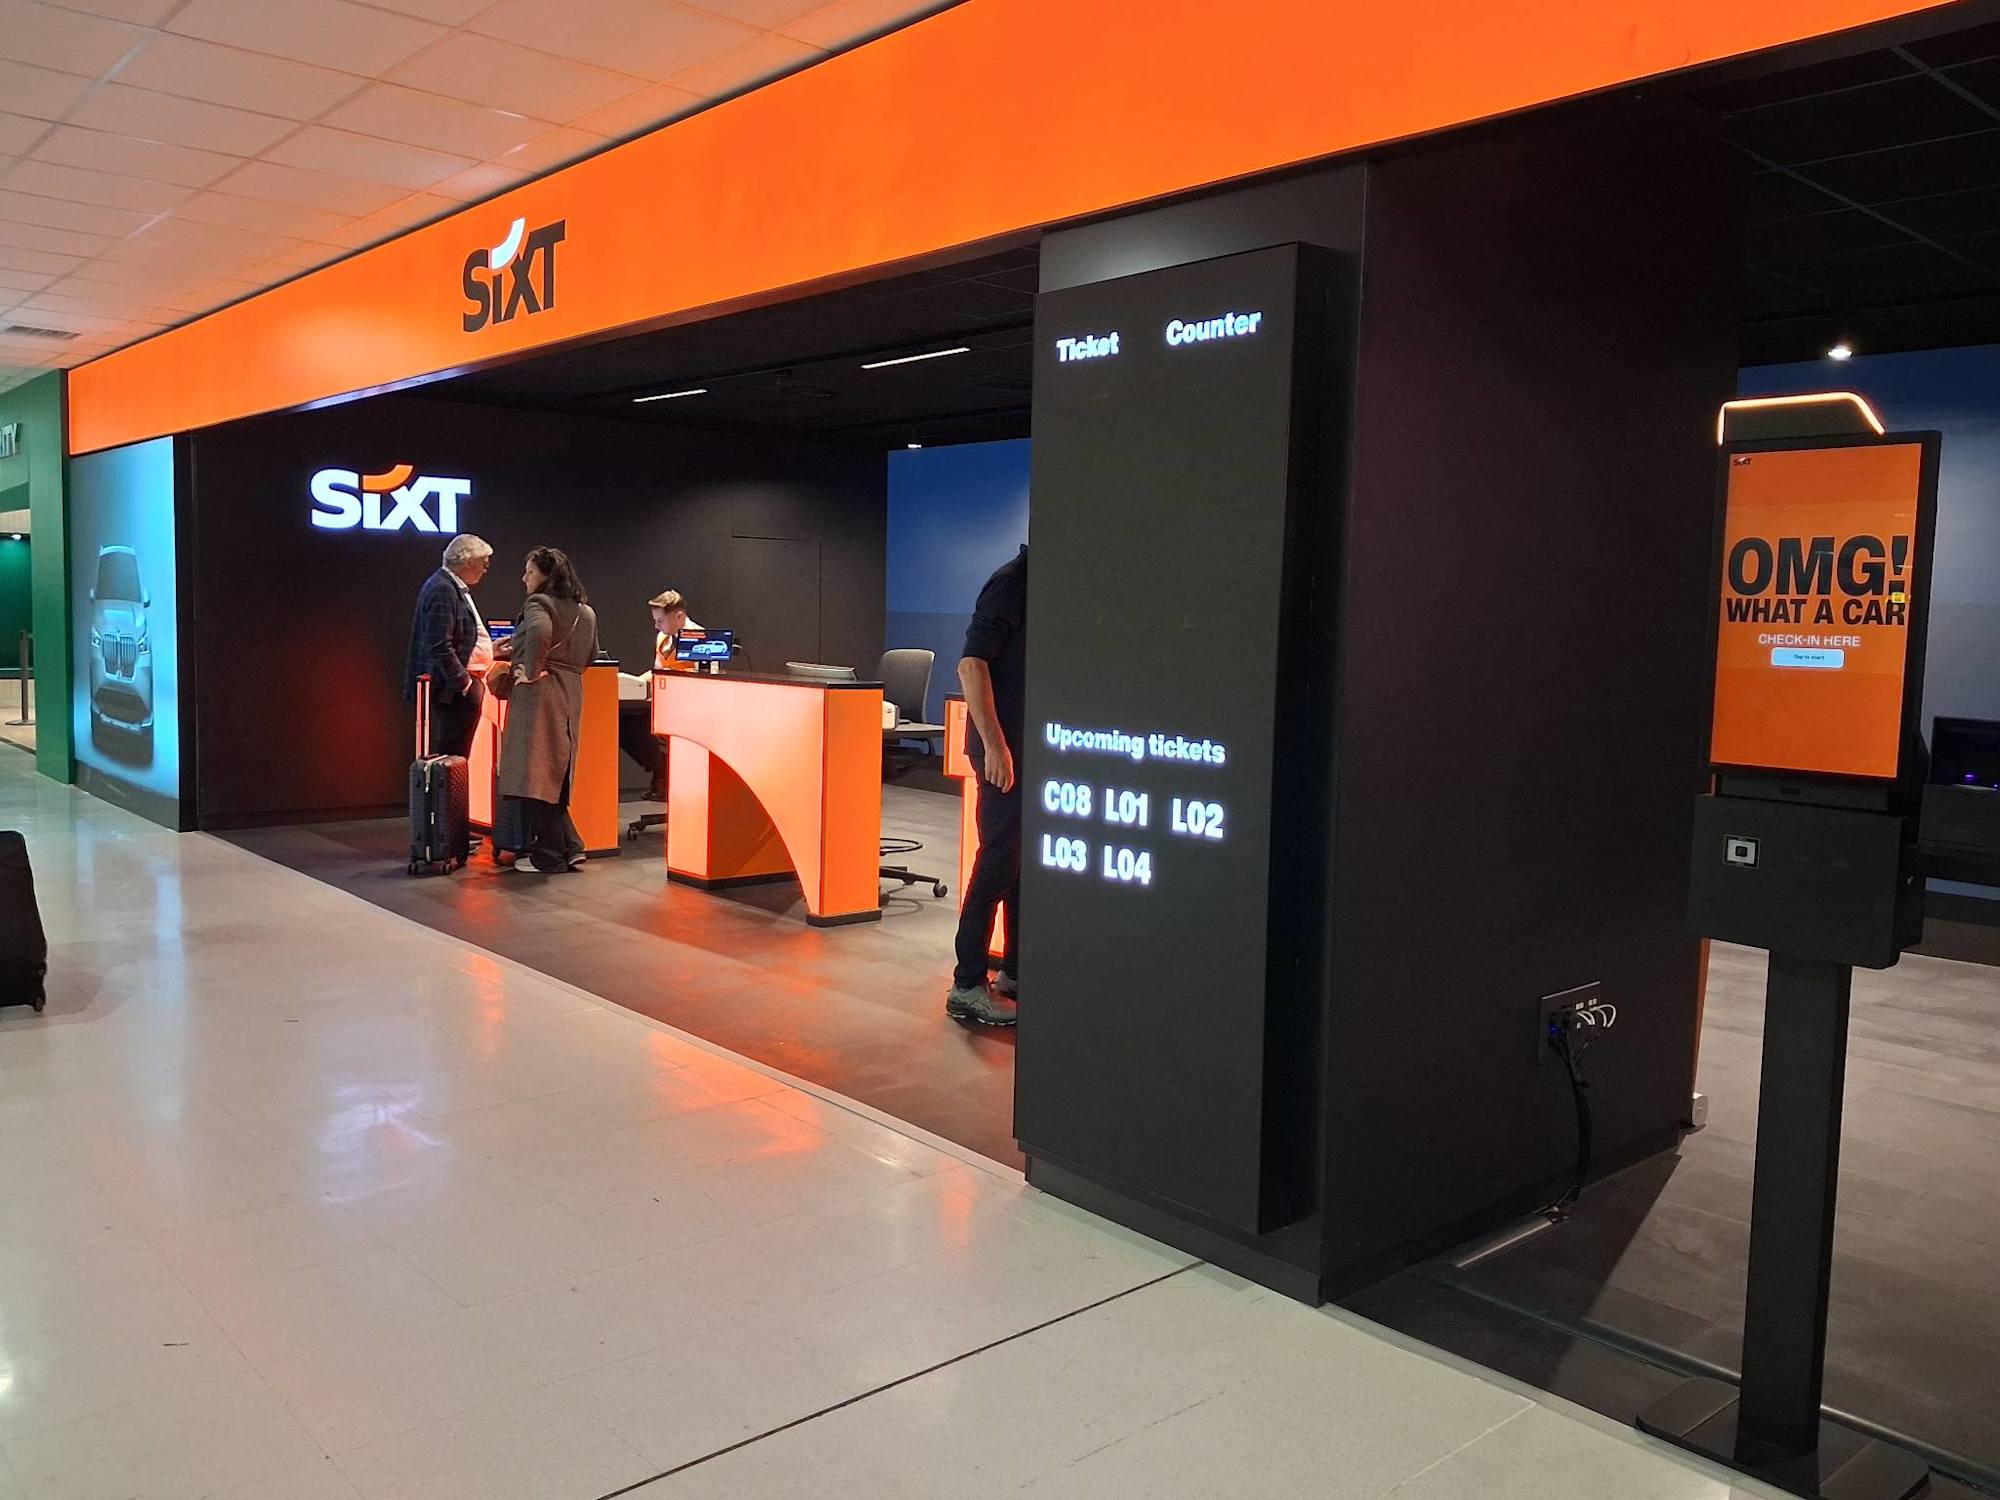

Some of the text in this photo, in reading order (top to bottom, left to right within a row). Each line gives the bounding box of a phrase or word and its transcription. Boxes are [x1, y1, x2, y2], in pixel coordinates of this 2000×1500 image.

[1056, 311, 1262, 362] Ticket Counter
[1729, 535, 1909, 596] OMG!
[1726, 598, 1906, 626] WHAT A CAR
[1758, 633, 1862, 647] CHECK-IN HERE
[1046, 723, 1226, 764] Upcoming tickets
[1044, 780, 1224, 839] C08 L01 L02
[1042, 834, 1152, 885] L03 L04
